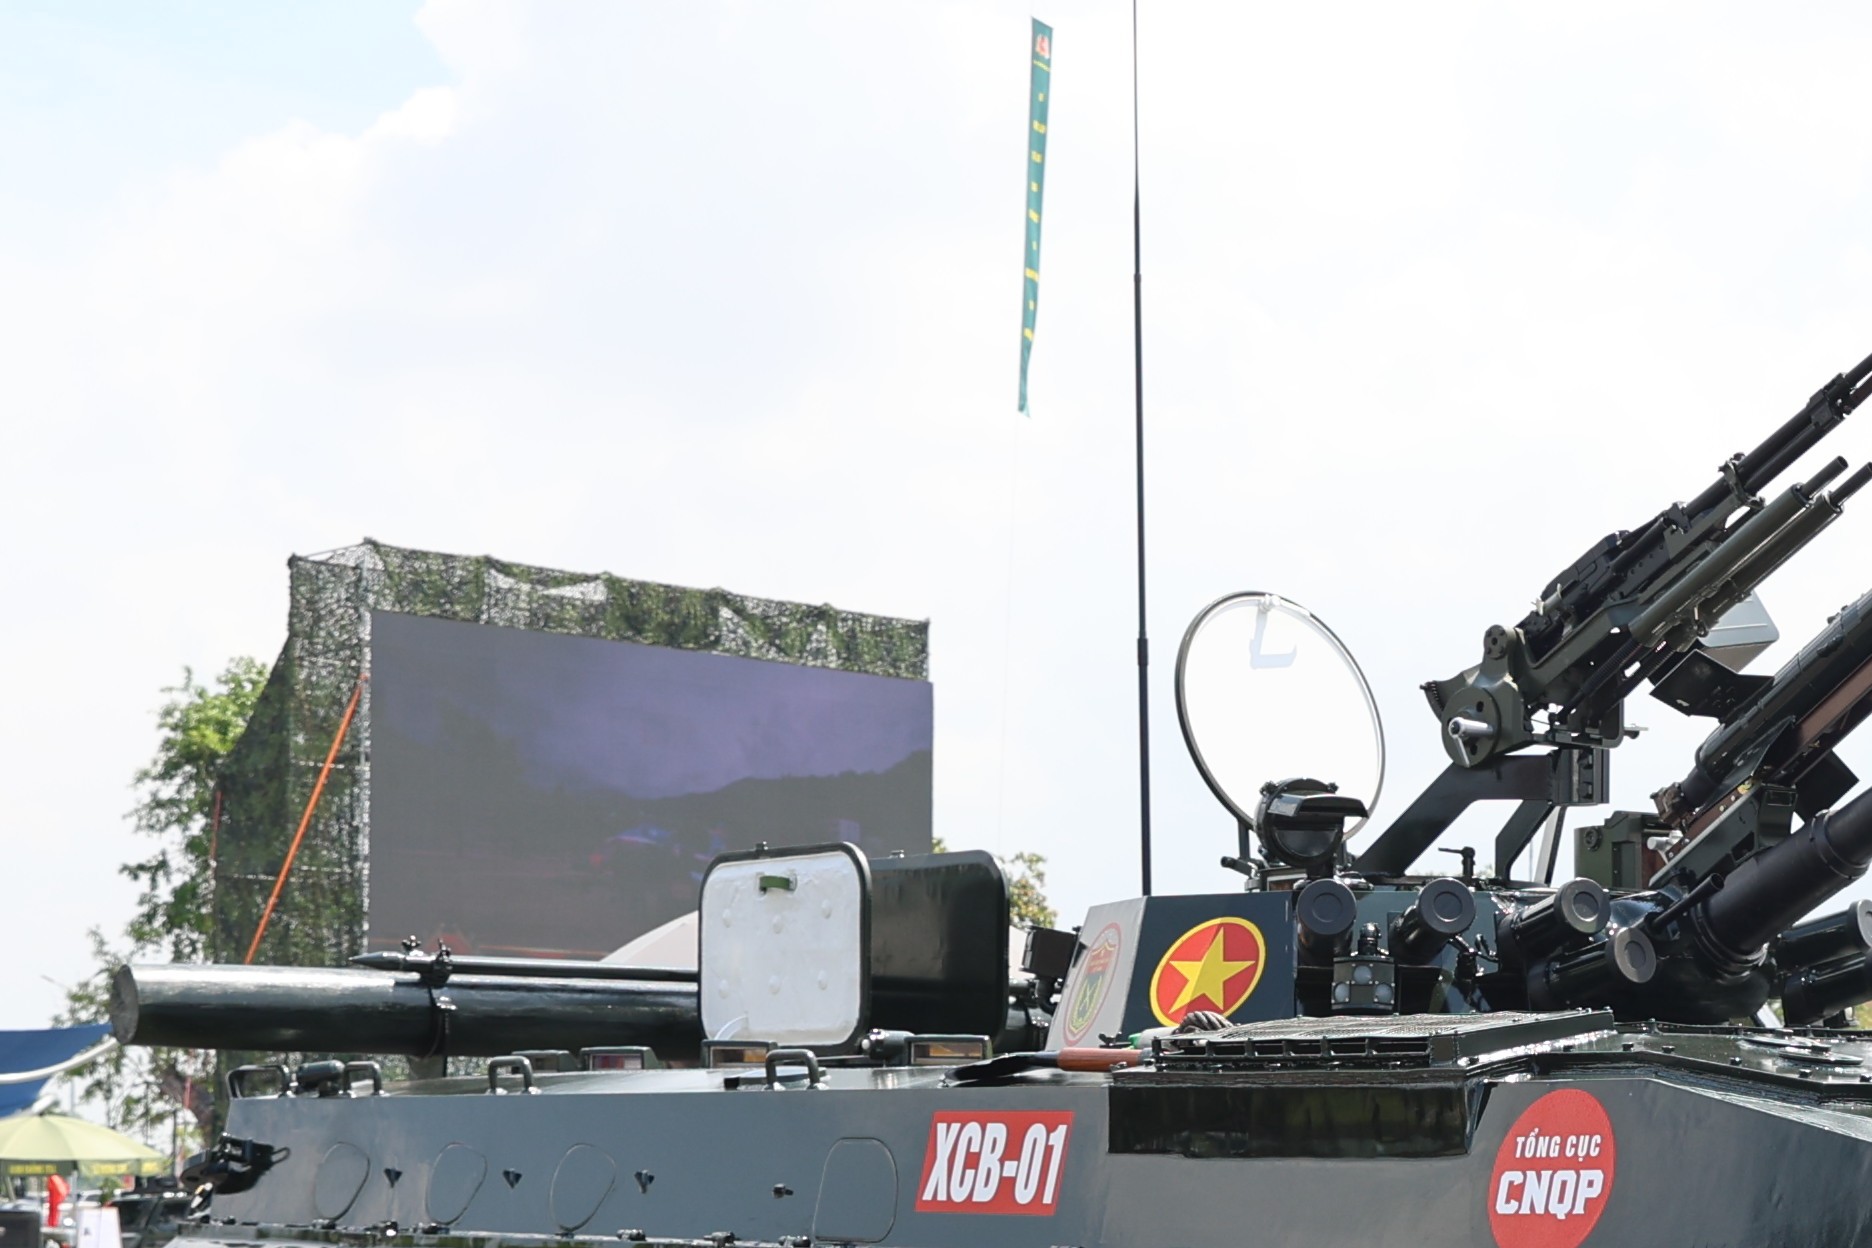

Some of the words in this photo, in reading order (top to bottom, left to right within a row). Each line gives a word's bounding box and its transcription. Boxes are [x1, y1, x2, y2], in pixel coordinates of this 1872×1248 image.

[922, 1122, 1067, 1204] XCB-01
[1515, 1127, 1560, 1158] TỔNG
[1565, 1134, 1601, 1162] CỤC
[1495, 1169, 1604, 1219] CNQP
